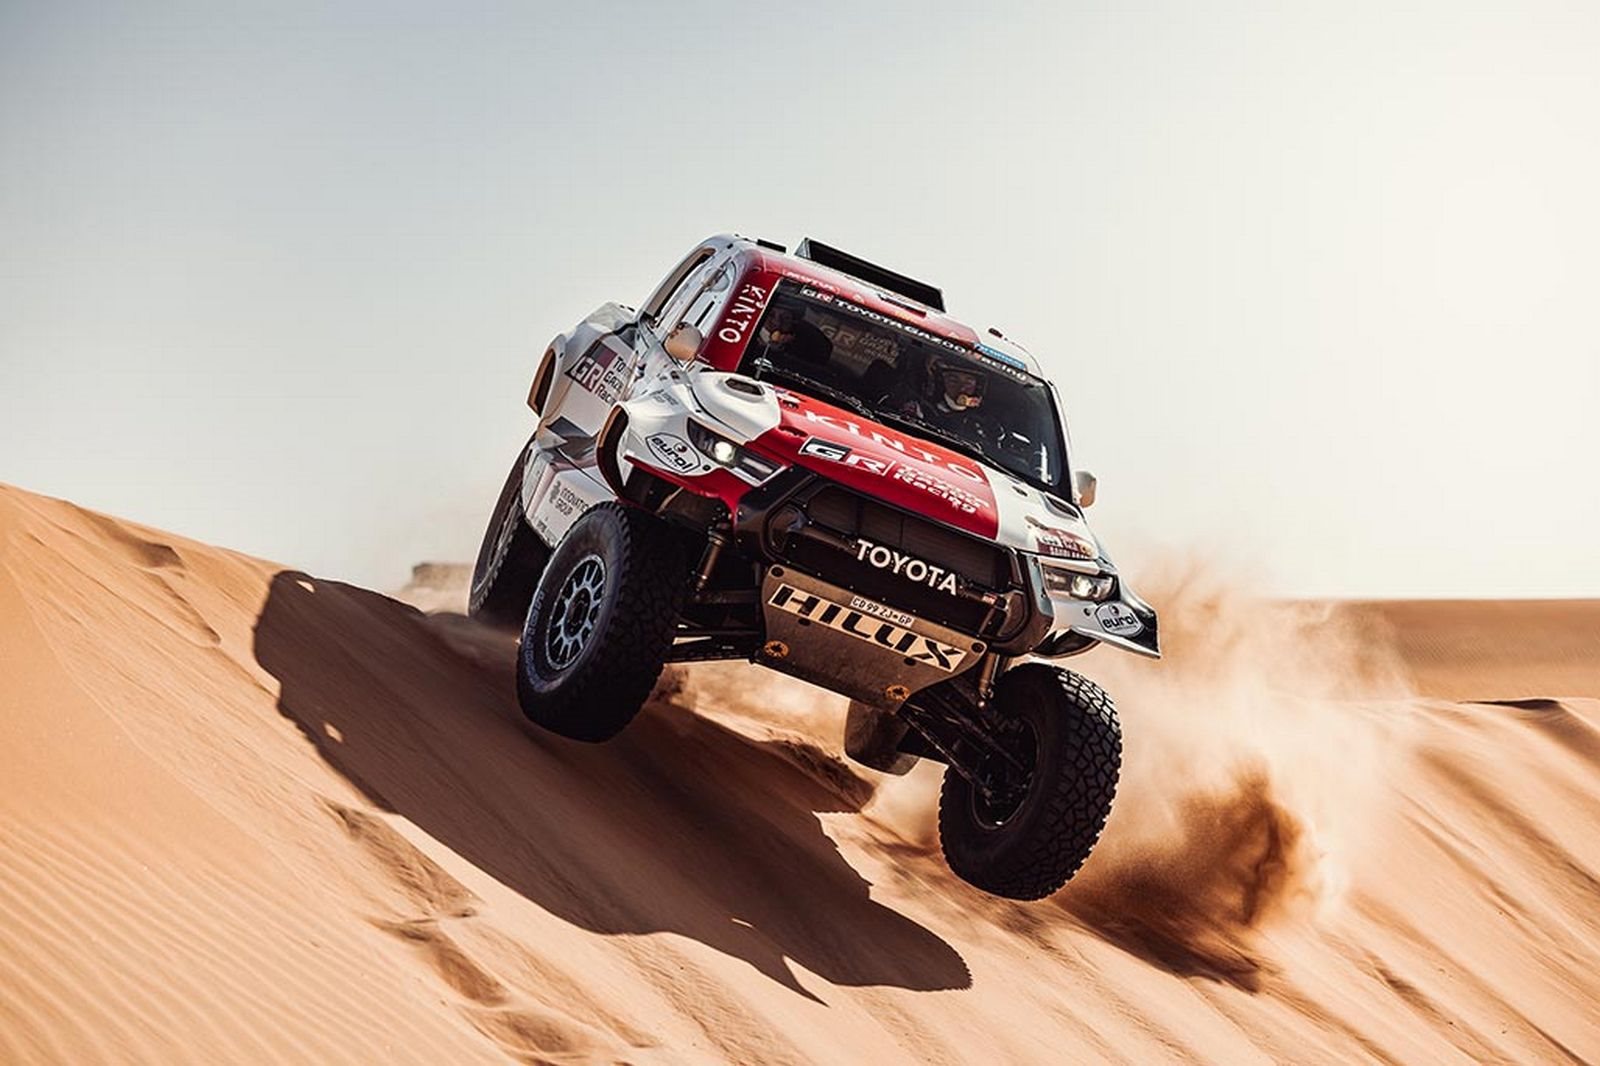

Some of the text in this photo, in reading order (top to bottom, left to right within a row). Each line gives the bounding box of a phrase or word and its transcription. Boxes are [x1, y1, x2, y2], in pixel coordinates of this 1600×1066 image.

[718, 284, 767, 343] KINTO
[835, 298, 903, 329] TOYOTA
[904, 325, 966, 353] GAZOO
[569, 356, 605, 390] GR
[651, 437, 693, 470] eurol
[803, 410, 986, 484] KINTO
[803, 442, 887, 476] GR
[892, 469, 977, 514] Racing
[856, 538, 957, 596] TOYOTA
[771, 586, 961, 670] HILUX
[866, 602, 879, 612] 99
[1102, 612, 1139, 629] eurol
